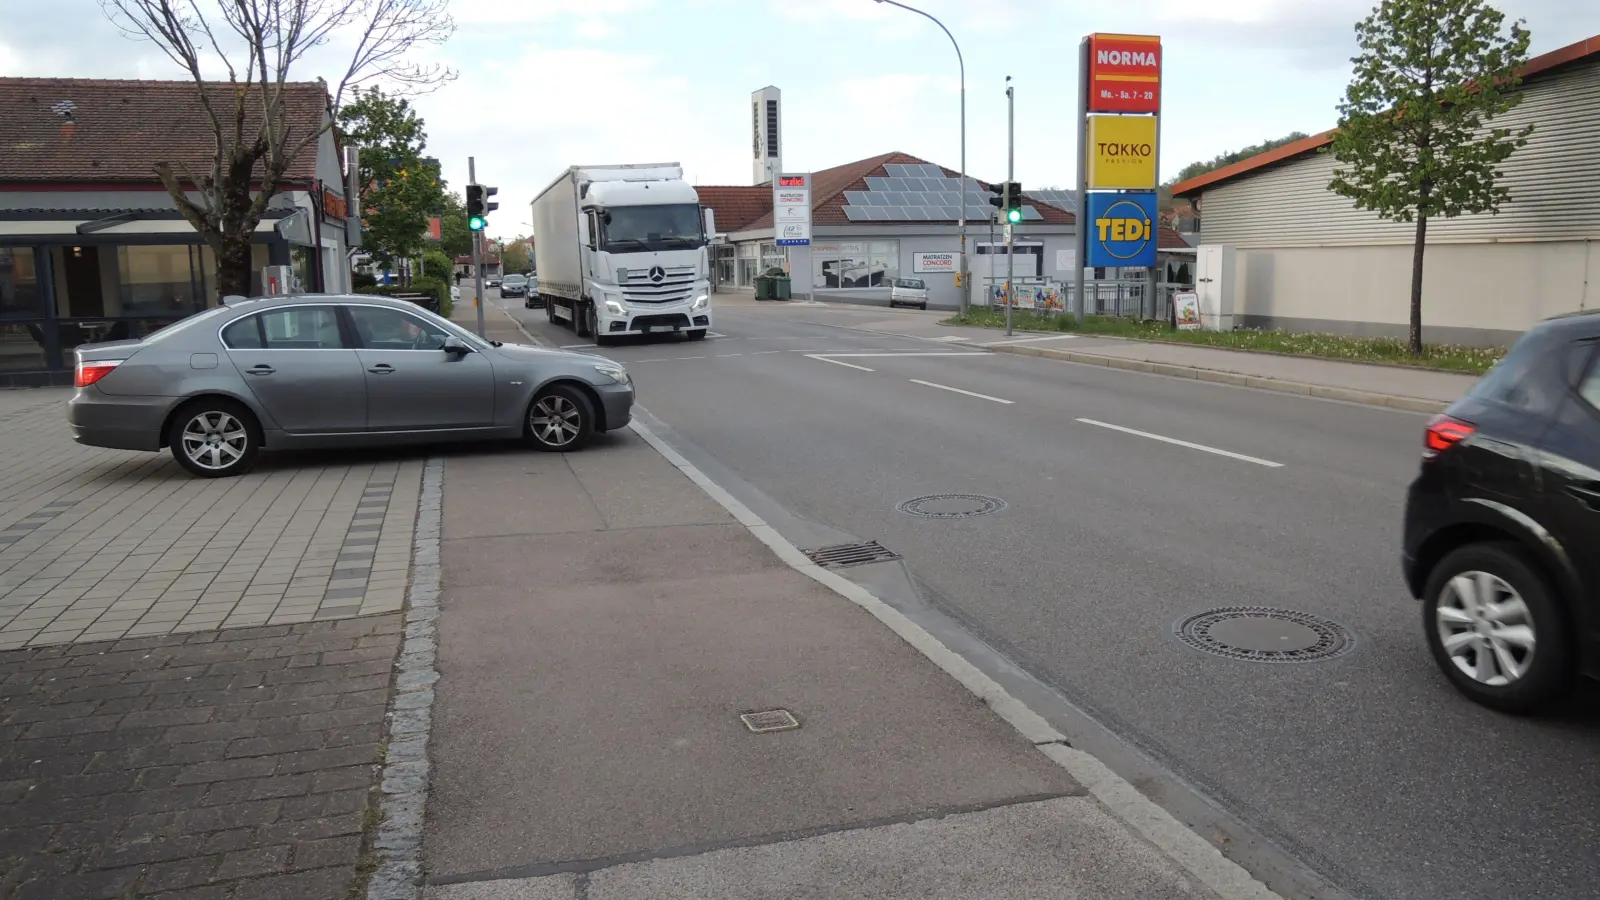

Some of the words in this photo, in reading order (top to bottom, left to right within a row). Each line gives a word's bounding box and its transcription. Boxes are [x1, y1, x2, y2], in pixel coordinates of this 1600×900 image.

[1098, 50, 1157, 66] NORMA
[1101, 90, 1114, 98] Mo.
[1120, 90, 1131, 99] Sa.
[1133, 91, 1137, 99] 7
[1144, 92, 1152, 100] 20
[1096, 218, 1151, 241] TEDi
